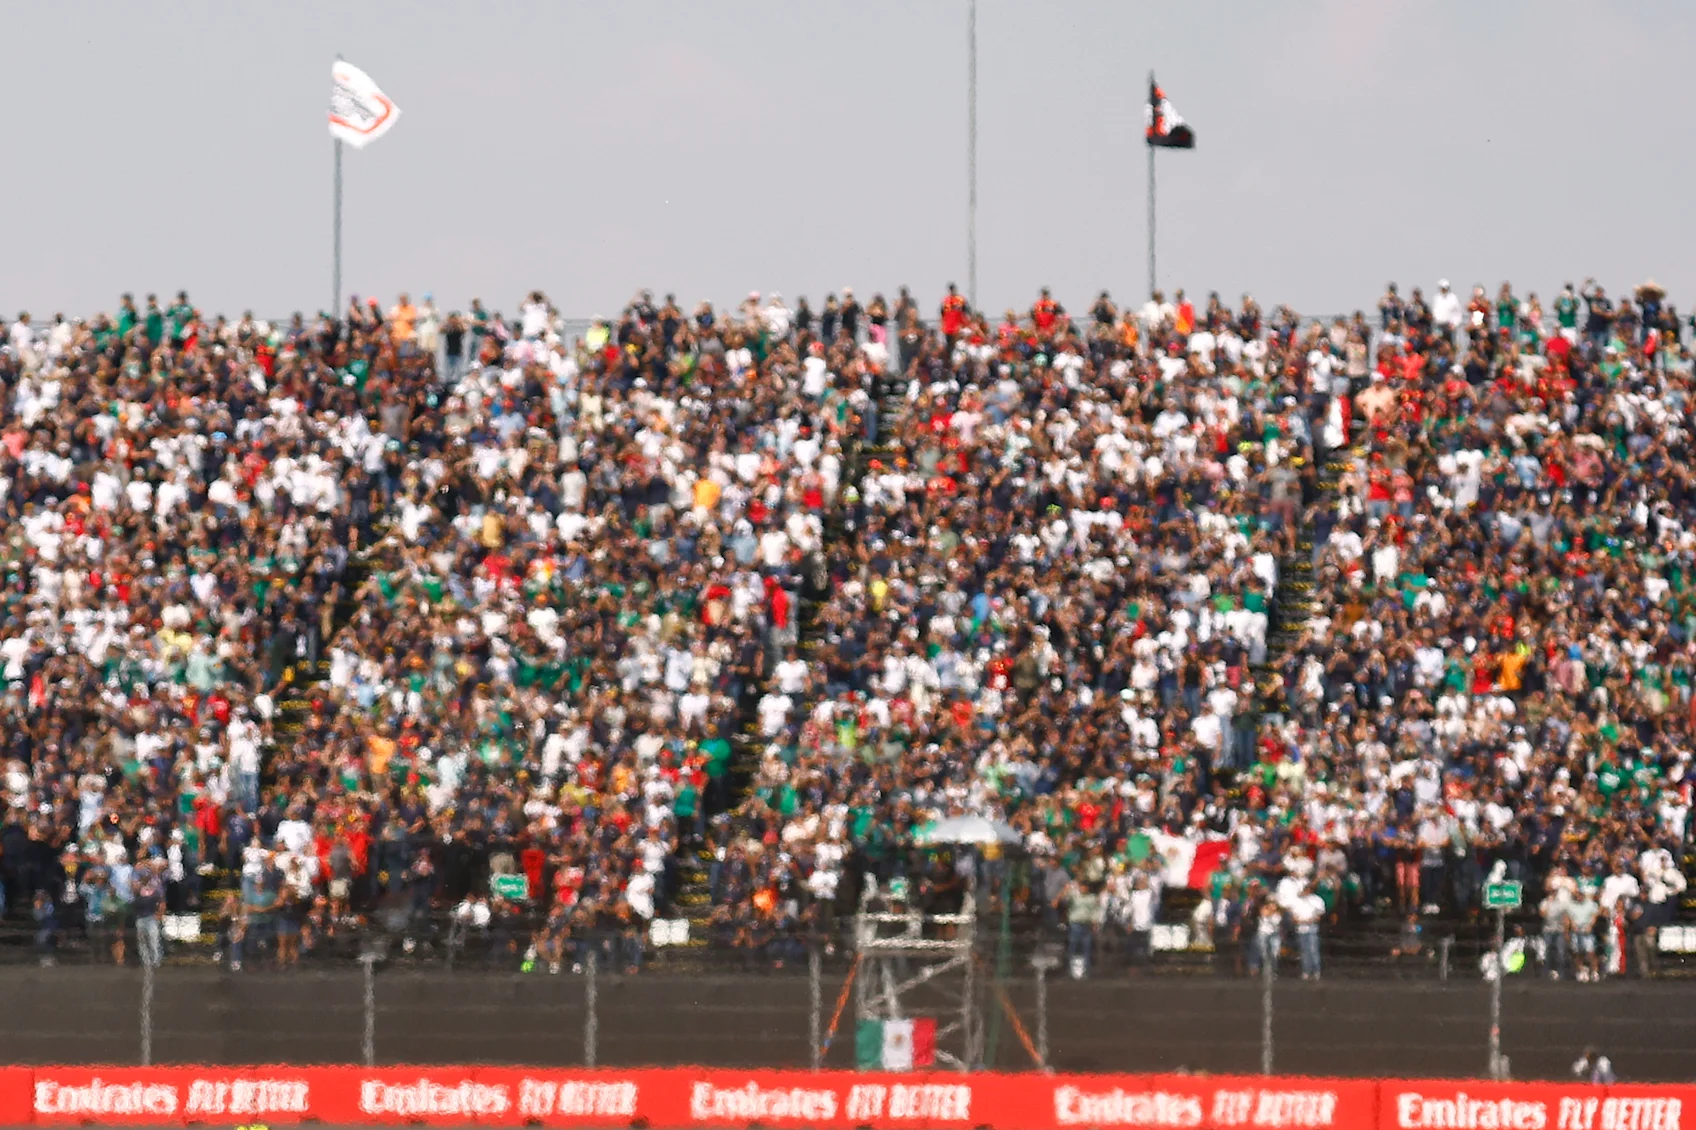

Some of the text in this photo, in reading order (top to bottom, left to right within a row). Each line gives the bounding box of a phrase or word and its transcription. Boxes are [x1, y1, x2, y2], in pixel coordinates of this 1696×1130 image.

[34, 1077, 177, 1114] Emirates
[361, 1079, 510, 1115] Emirates
[691, 1081, 971, 1120] Emirates FLY BETTER
[1054, 1086, 1336, 1126] Emirates FLY BETTER
[1397, 1093, 1546, 1130] Emirates
